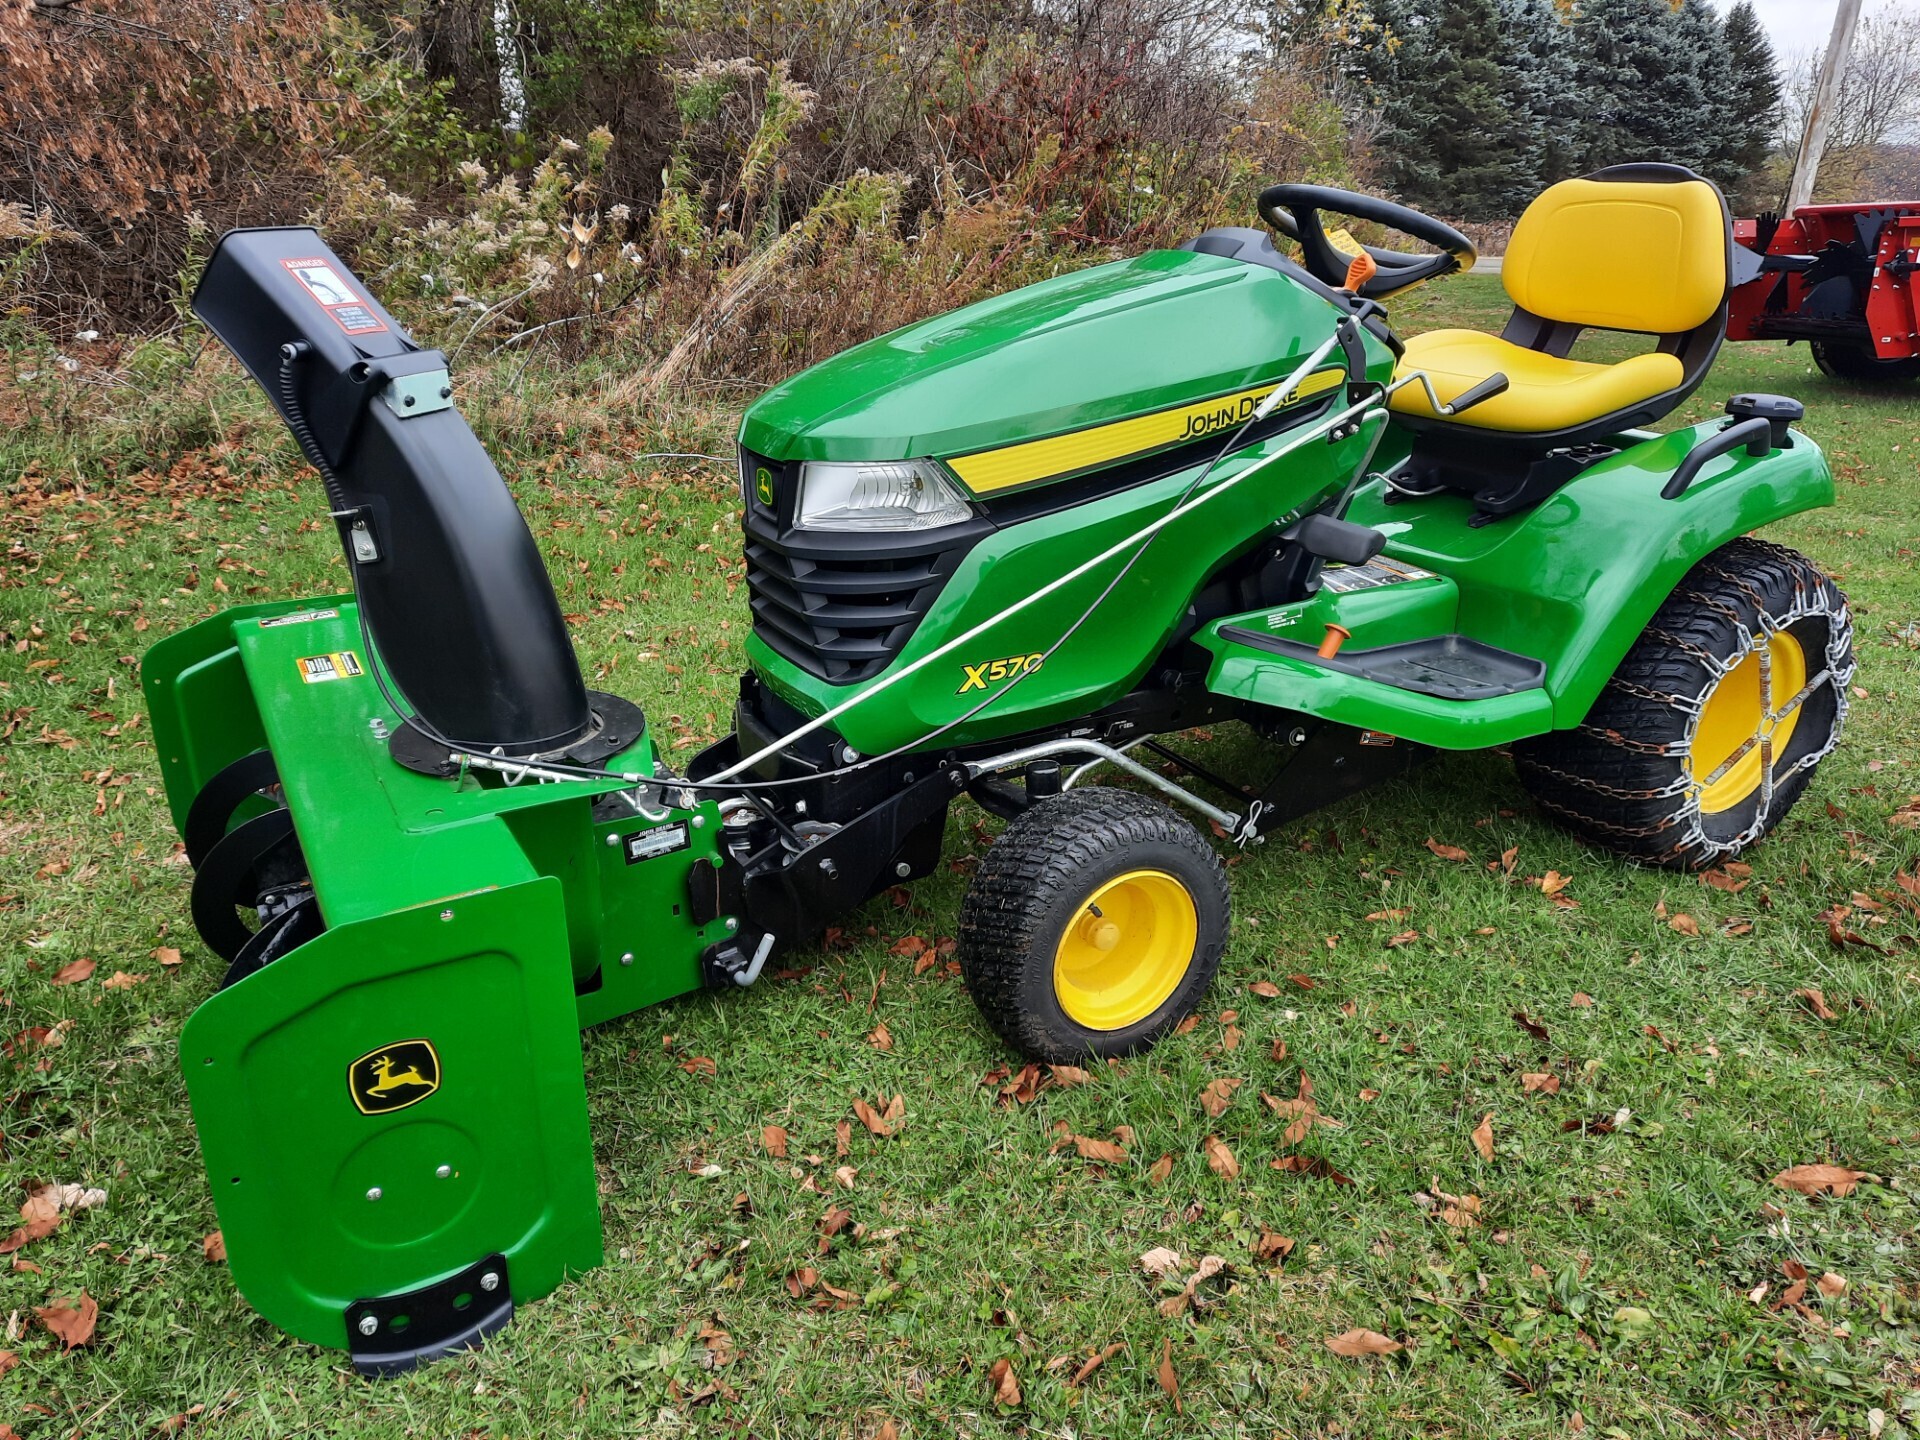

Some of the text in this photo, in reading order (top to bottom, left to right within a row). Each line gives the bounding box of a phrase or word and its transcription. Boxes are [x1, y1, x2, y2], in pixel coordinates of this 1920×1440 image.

[291, 259, 324, 268] DANGER
[1179, 406, 1234, 439] JOHN
[955, 652, 1044, 695] X570
